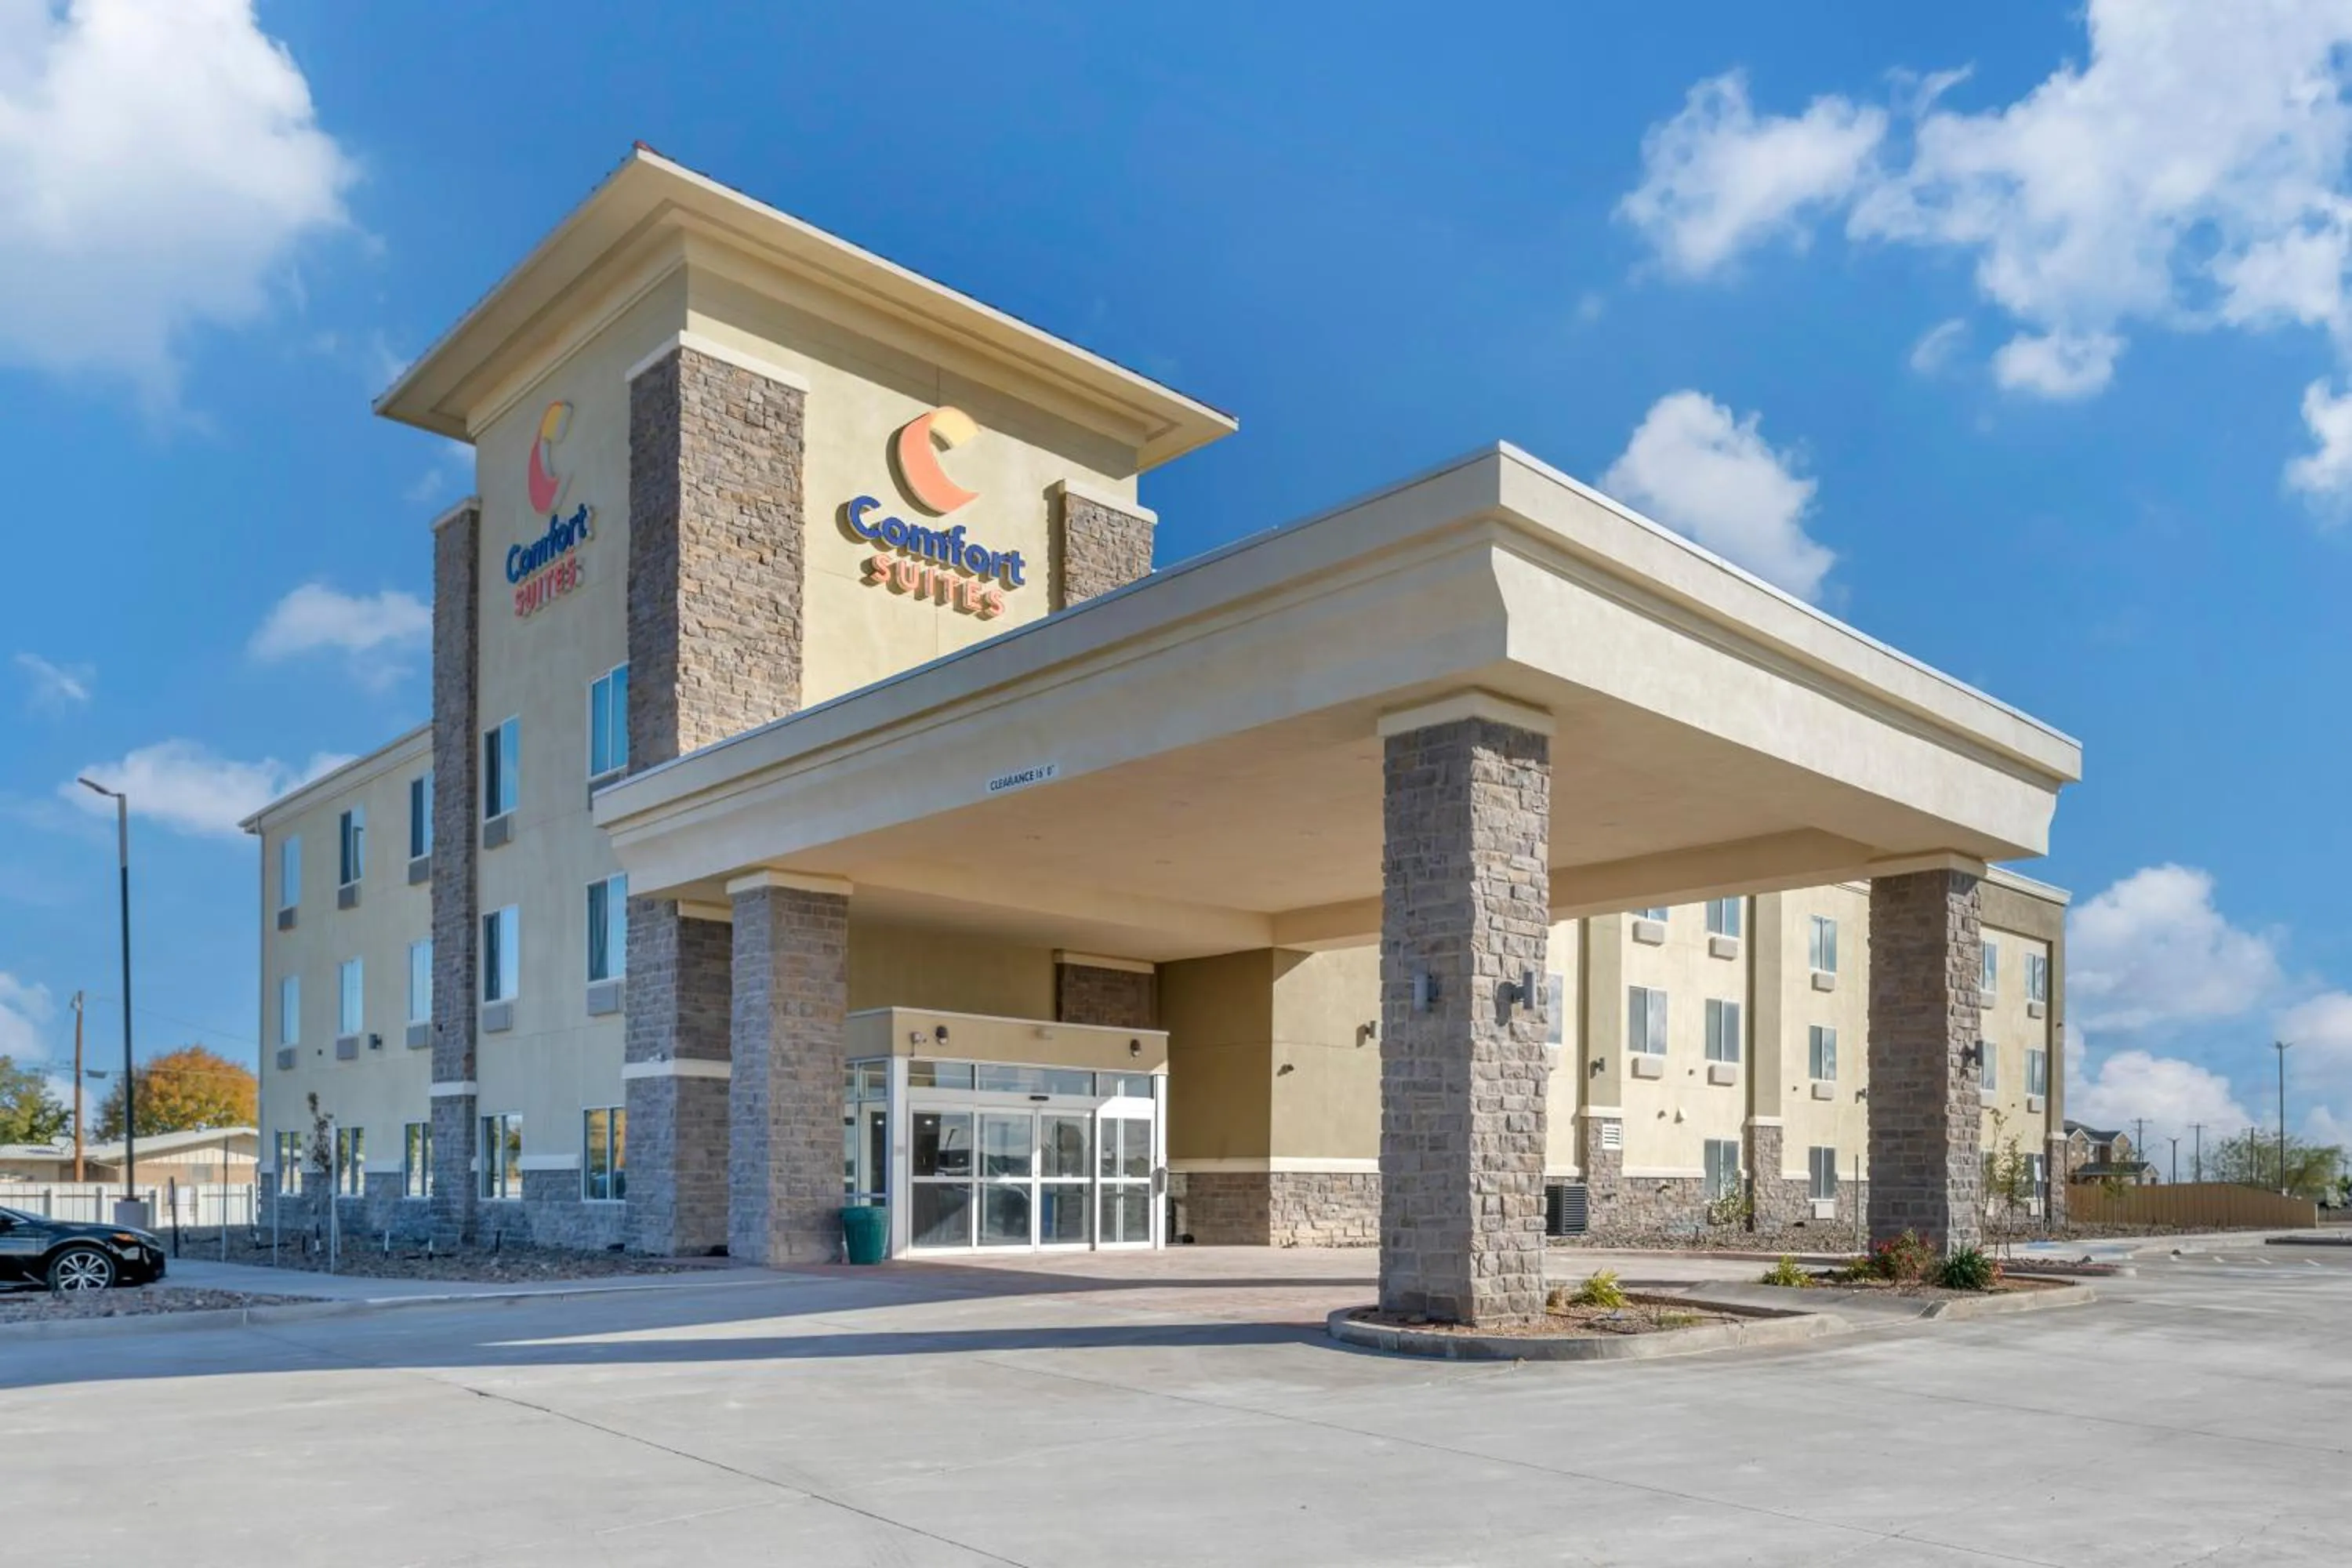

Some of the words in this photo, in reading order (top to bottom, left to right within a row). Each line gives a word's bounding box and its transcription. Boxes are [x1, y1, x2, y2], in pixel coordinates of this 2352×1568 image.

[506, 503, 588, 583] Comfort
[848, 495, 1025, 586] Comfort
[514, 554, 577, 617] SUITES
[870, 554, 1005, 616] SUITES
